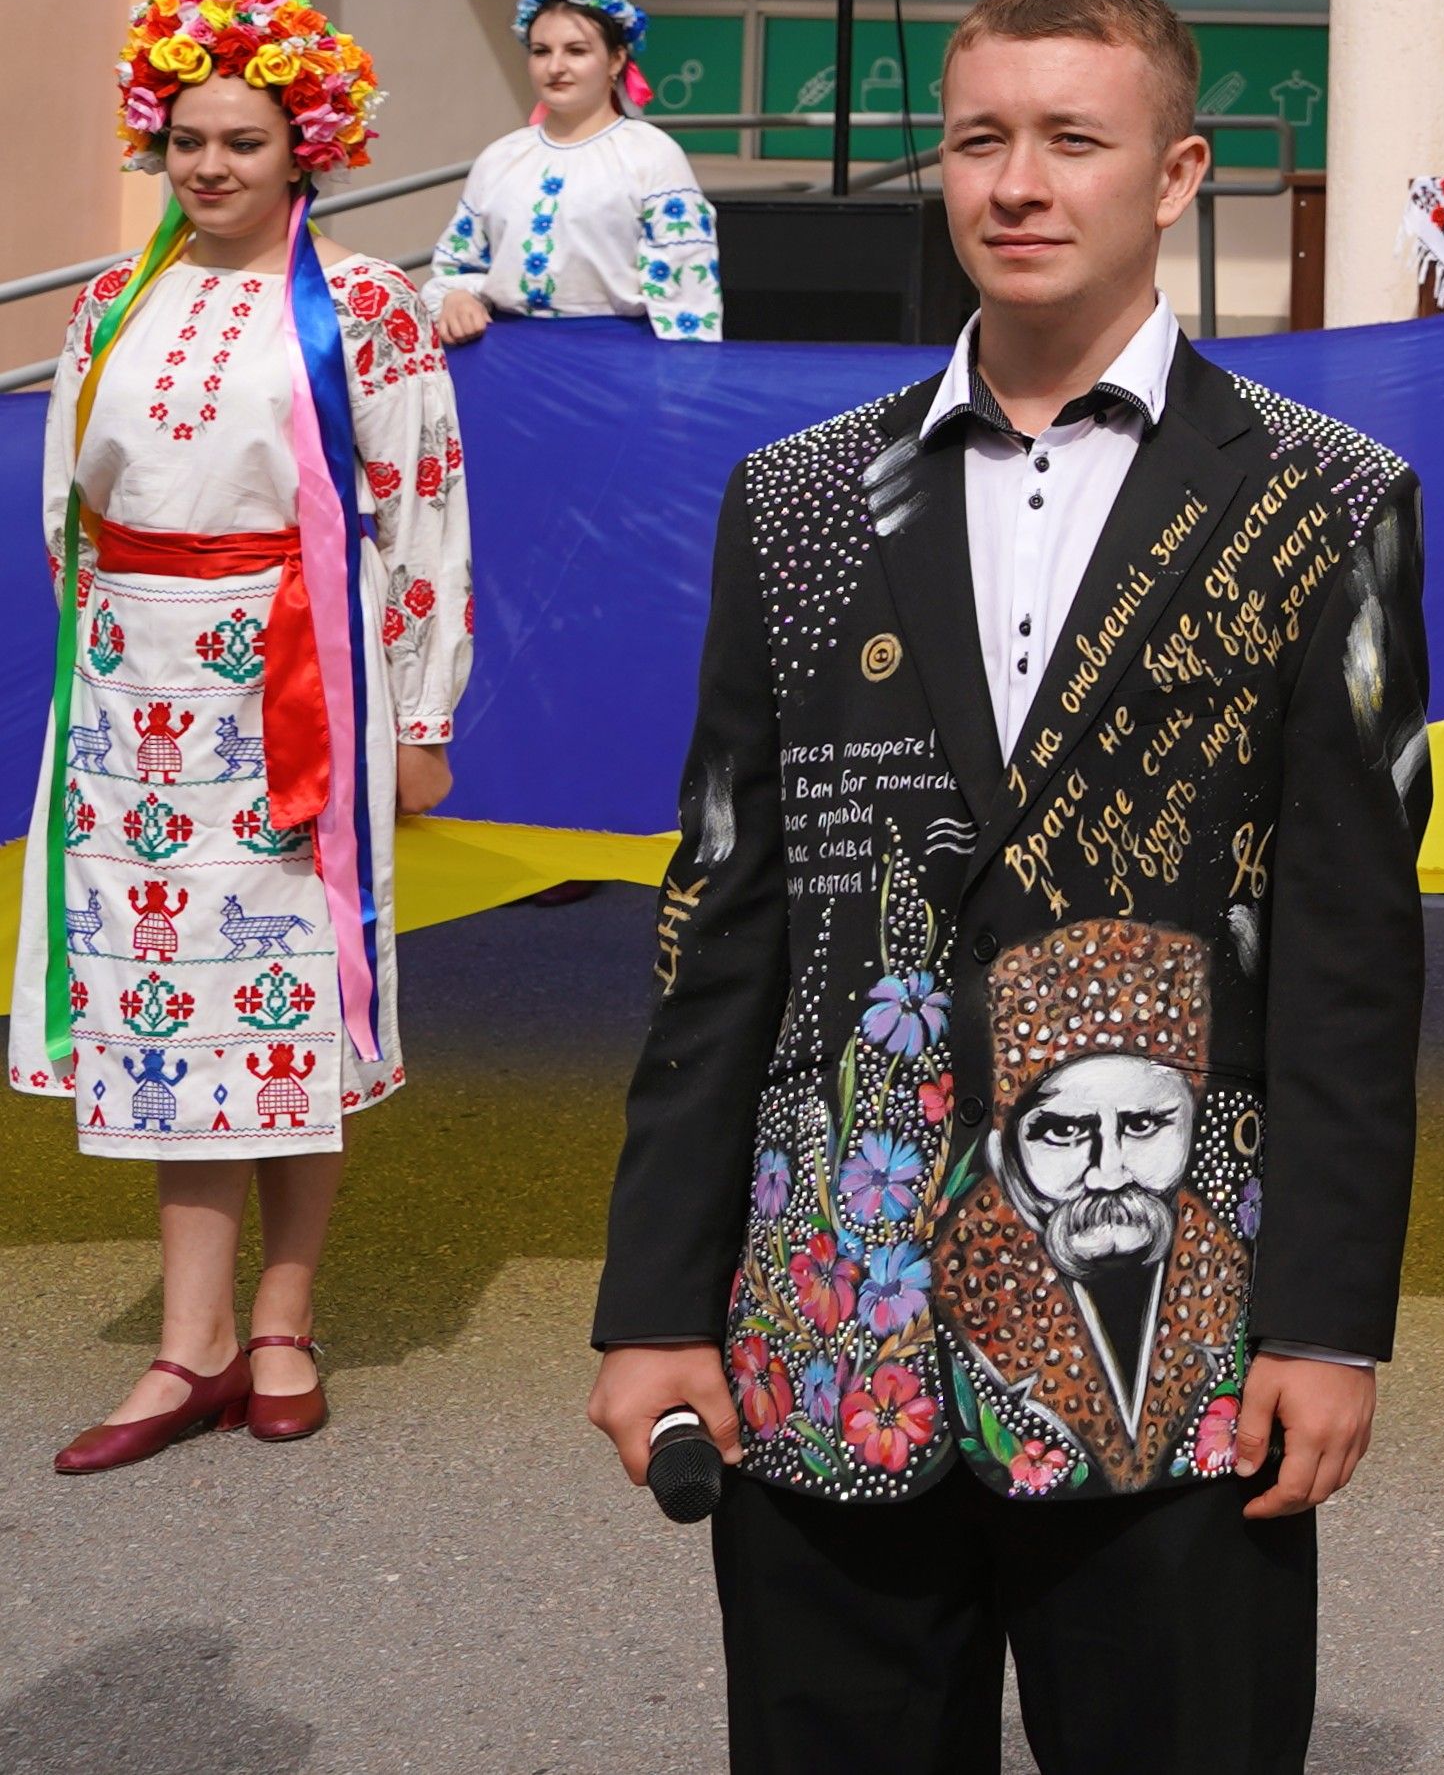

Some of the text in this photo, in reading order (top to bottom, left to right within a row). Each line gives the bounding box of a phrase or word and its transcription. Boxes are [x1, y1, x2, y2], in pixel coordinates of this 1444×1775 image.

[1030, 728, 1063, 769] на
[1098, 704, 1136, 756] не
[818, 799, 874, 838] правда
[818, 836, 873, 860] слава
